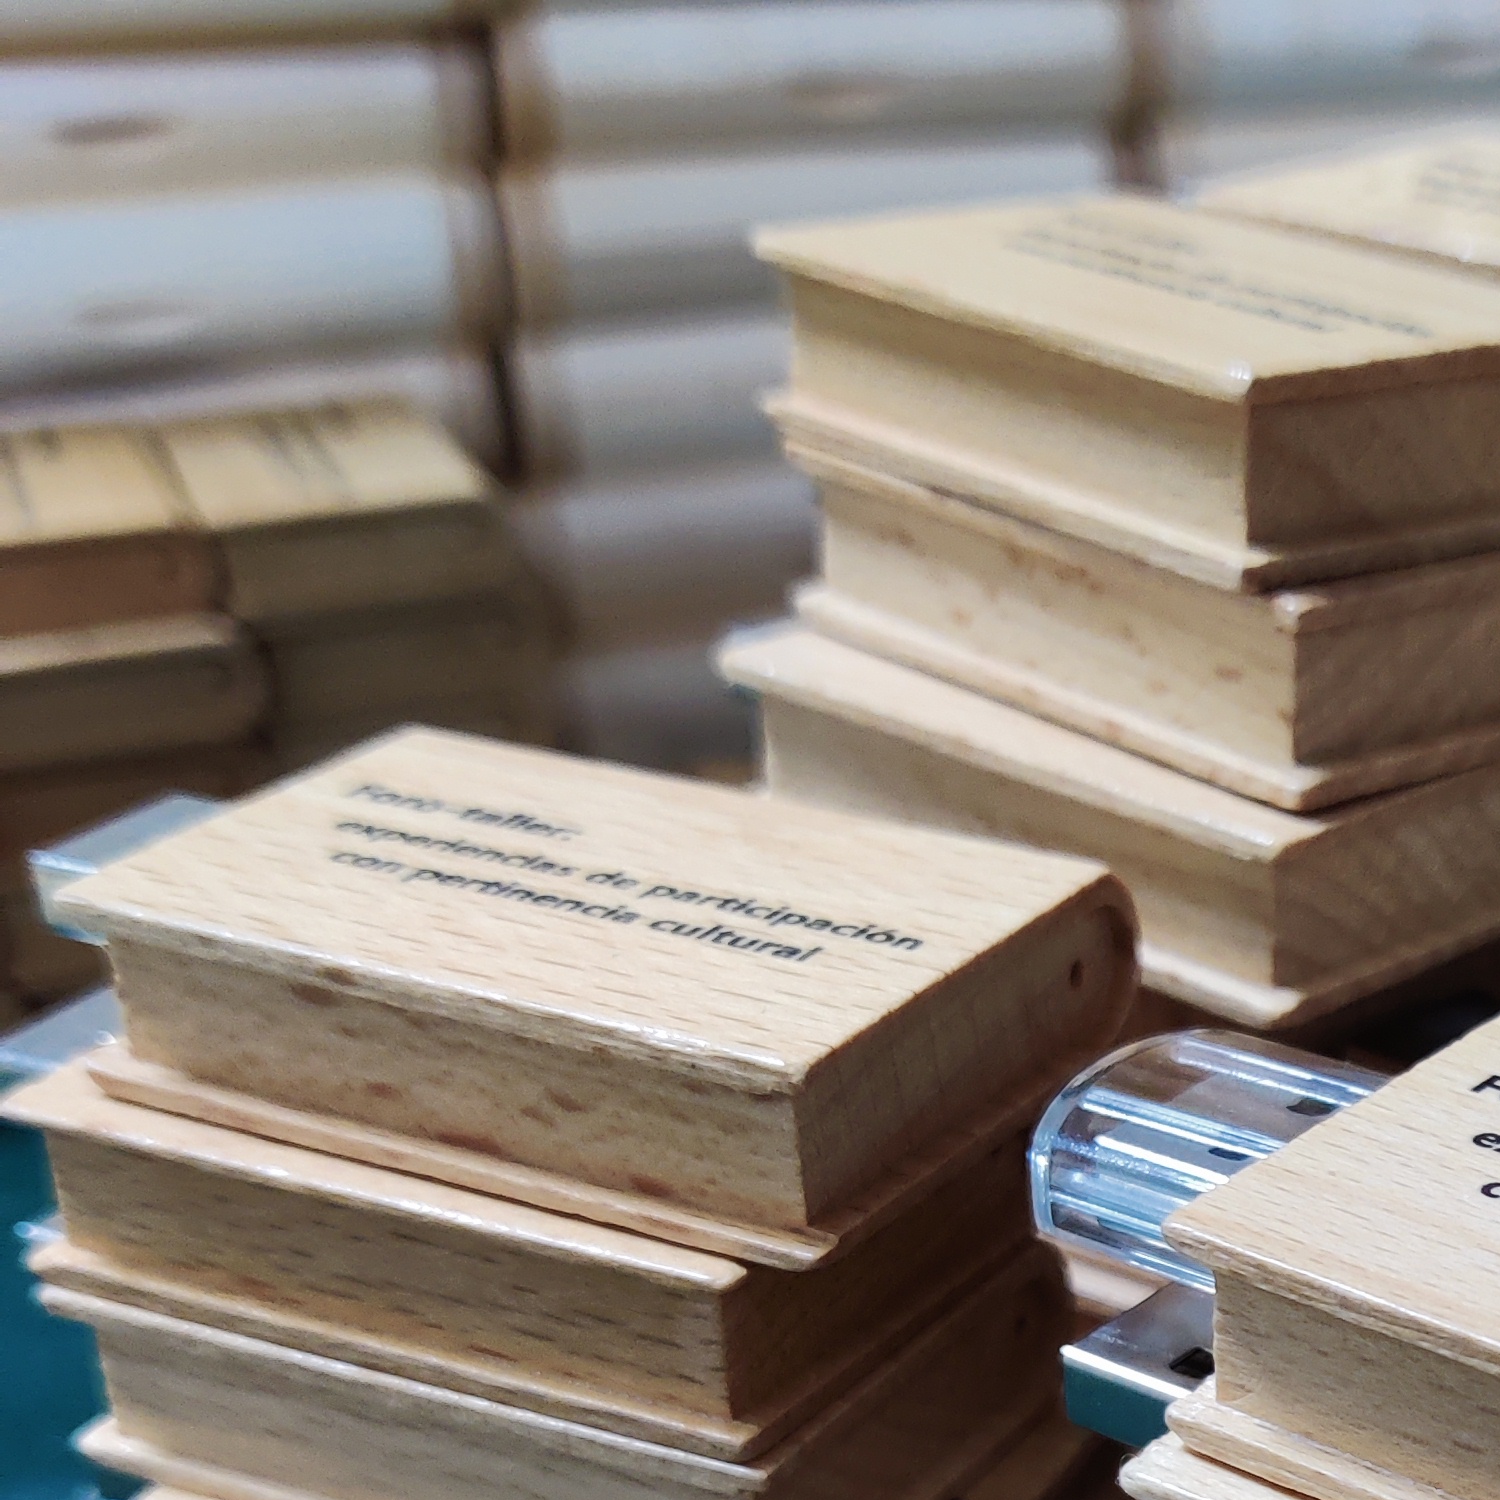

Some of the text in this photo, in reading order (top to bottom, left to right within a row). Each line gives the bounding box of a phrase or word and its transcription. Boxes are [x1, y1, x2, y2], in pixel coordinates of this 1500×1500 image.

[330, 852, 826, 963] con pertinencia cultural
[336, 822, 925, 951] experiencias de participación
